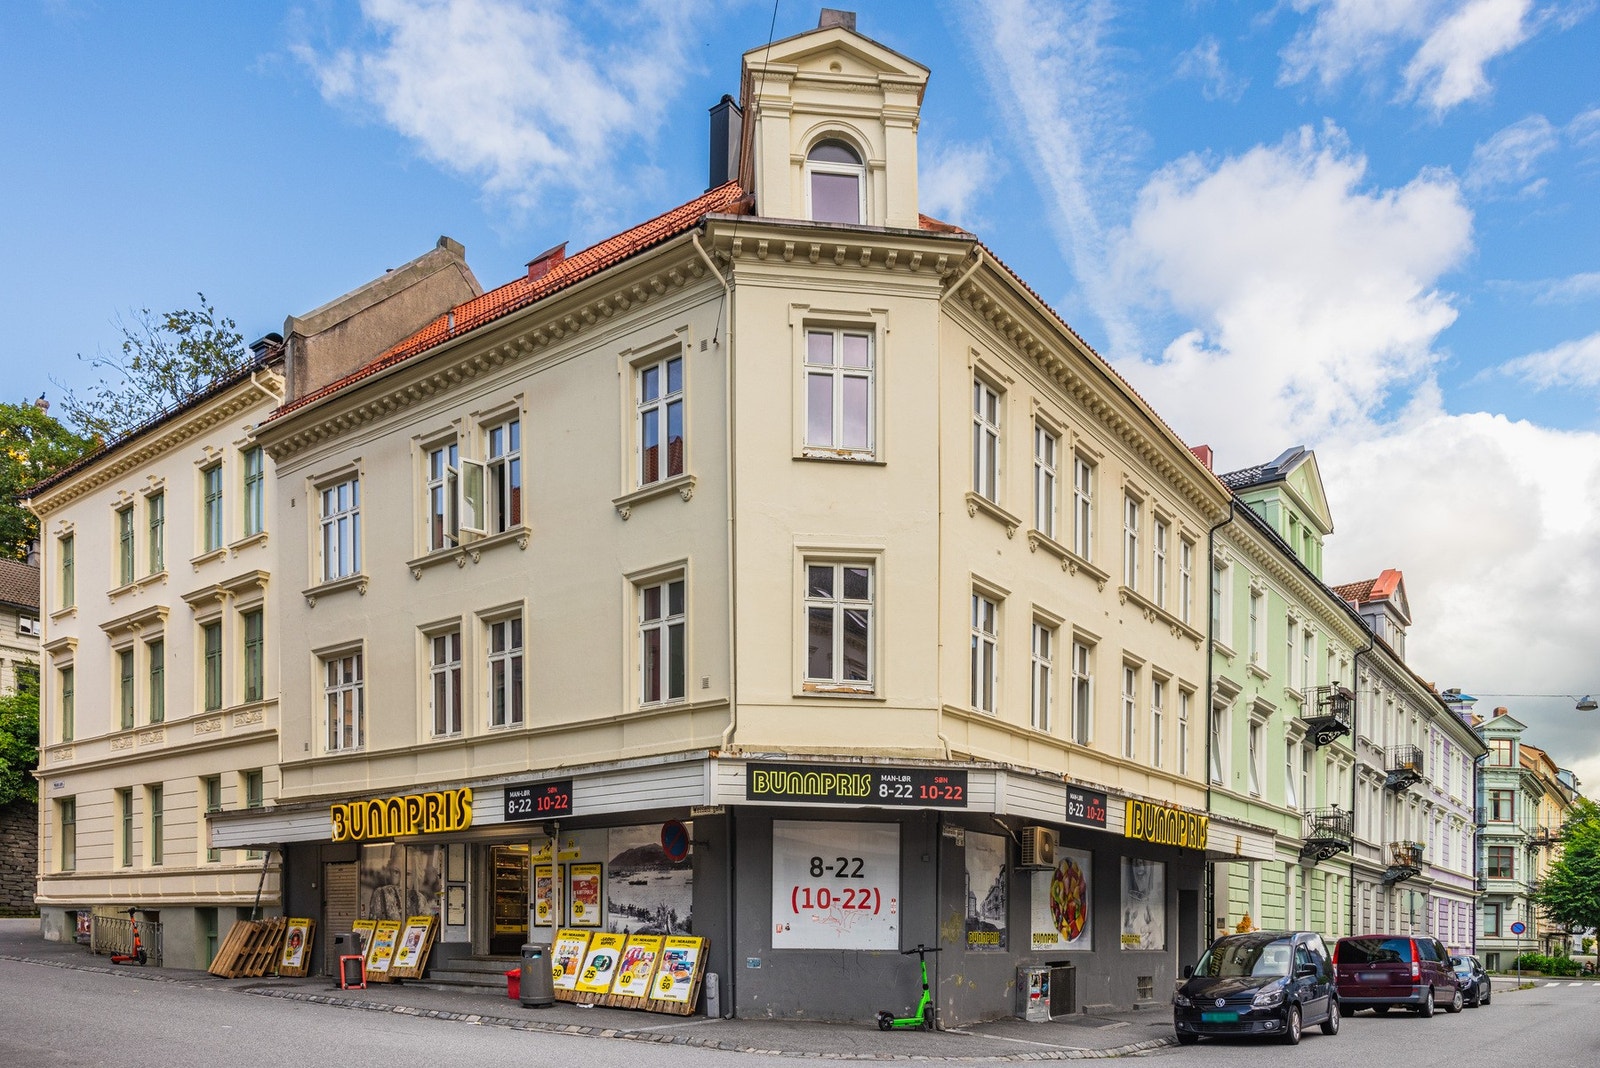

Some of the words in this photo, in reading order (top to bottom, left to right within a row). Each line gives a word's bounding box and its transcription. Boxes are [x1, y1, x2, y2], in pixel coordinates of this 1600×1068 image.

[753, 770, 871, 797] BUNNPRIS
[881, 775, 911, 783] MAN-LØR
[934, 776, 948, 784] SØN
[879, 784, 913, 799] 8-22
[919, 785, 963, 800] 10-22
[508, 799, 532, 814] 8-22
[537, 794, 568, 811] 10-22
[1068, 801, 1084, 817] 8-22
[1086, 805, 1105, 821] 10-22
[330, 788, 473, 842] BUNNPRIS
[1130, 800, 1208, 850] BUNNPRIS
[809, 856, 865, 879] 8-22
[791, 886, 881, 915] (10-22)
[553, 969, 561, 977] 20
[584, 970, 595, 979] 25
[621, 975, 631, 984] 10
[662, 982, 671, 990] 50
